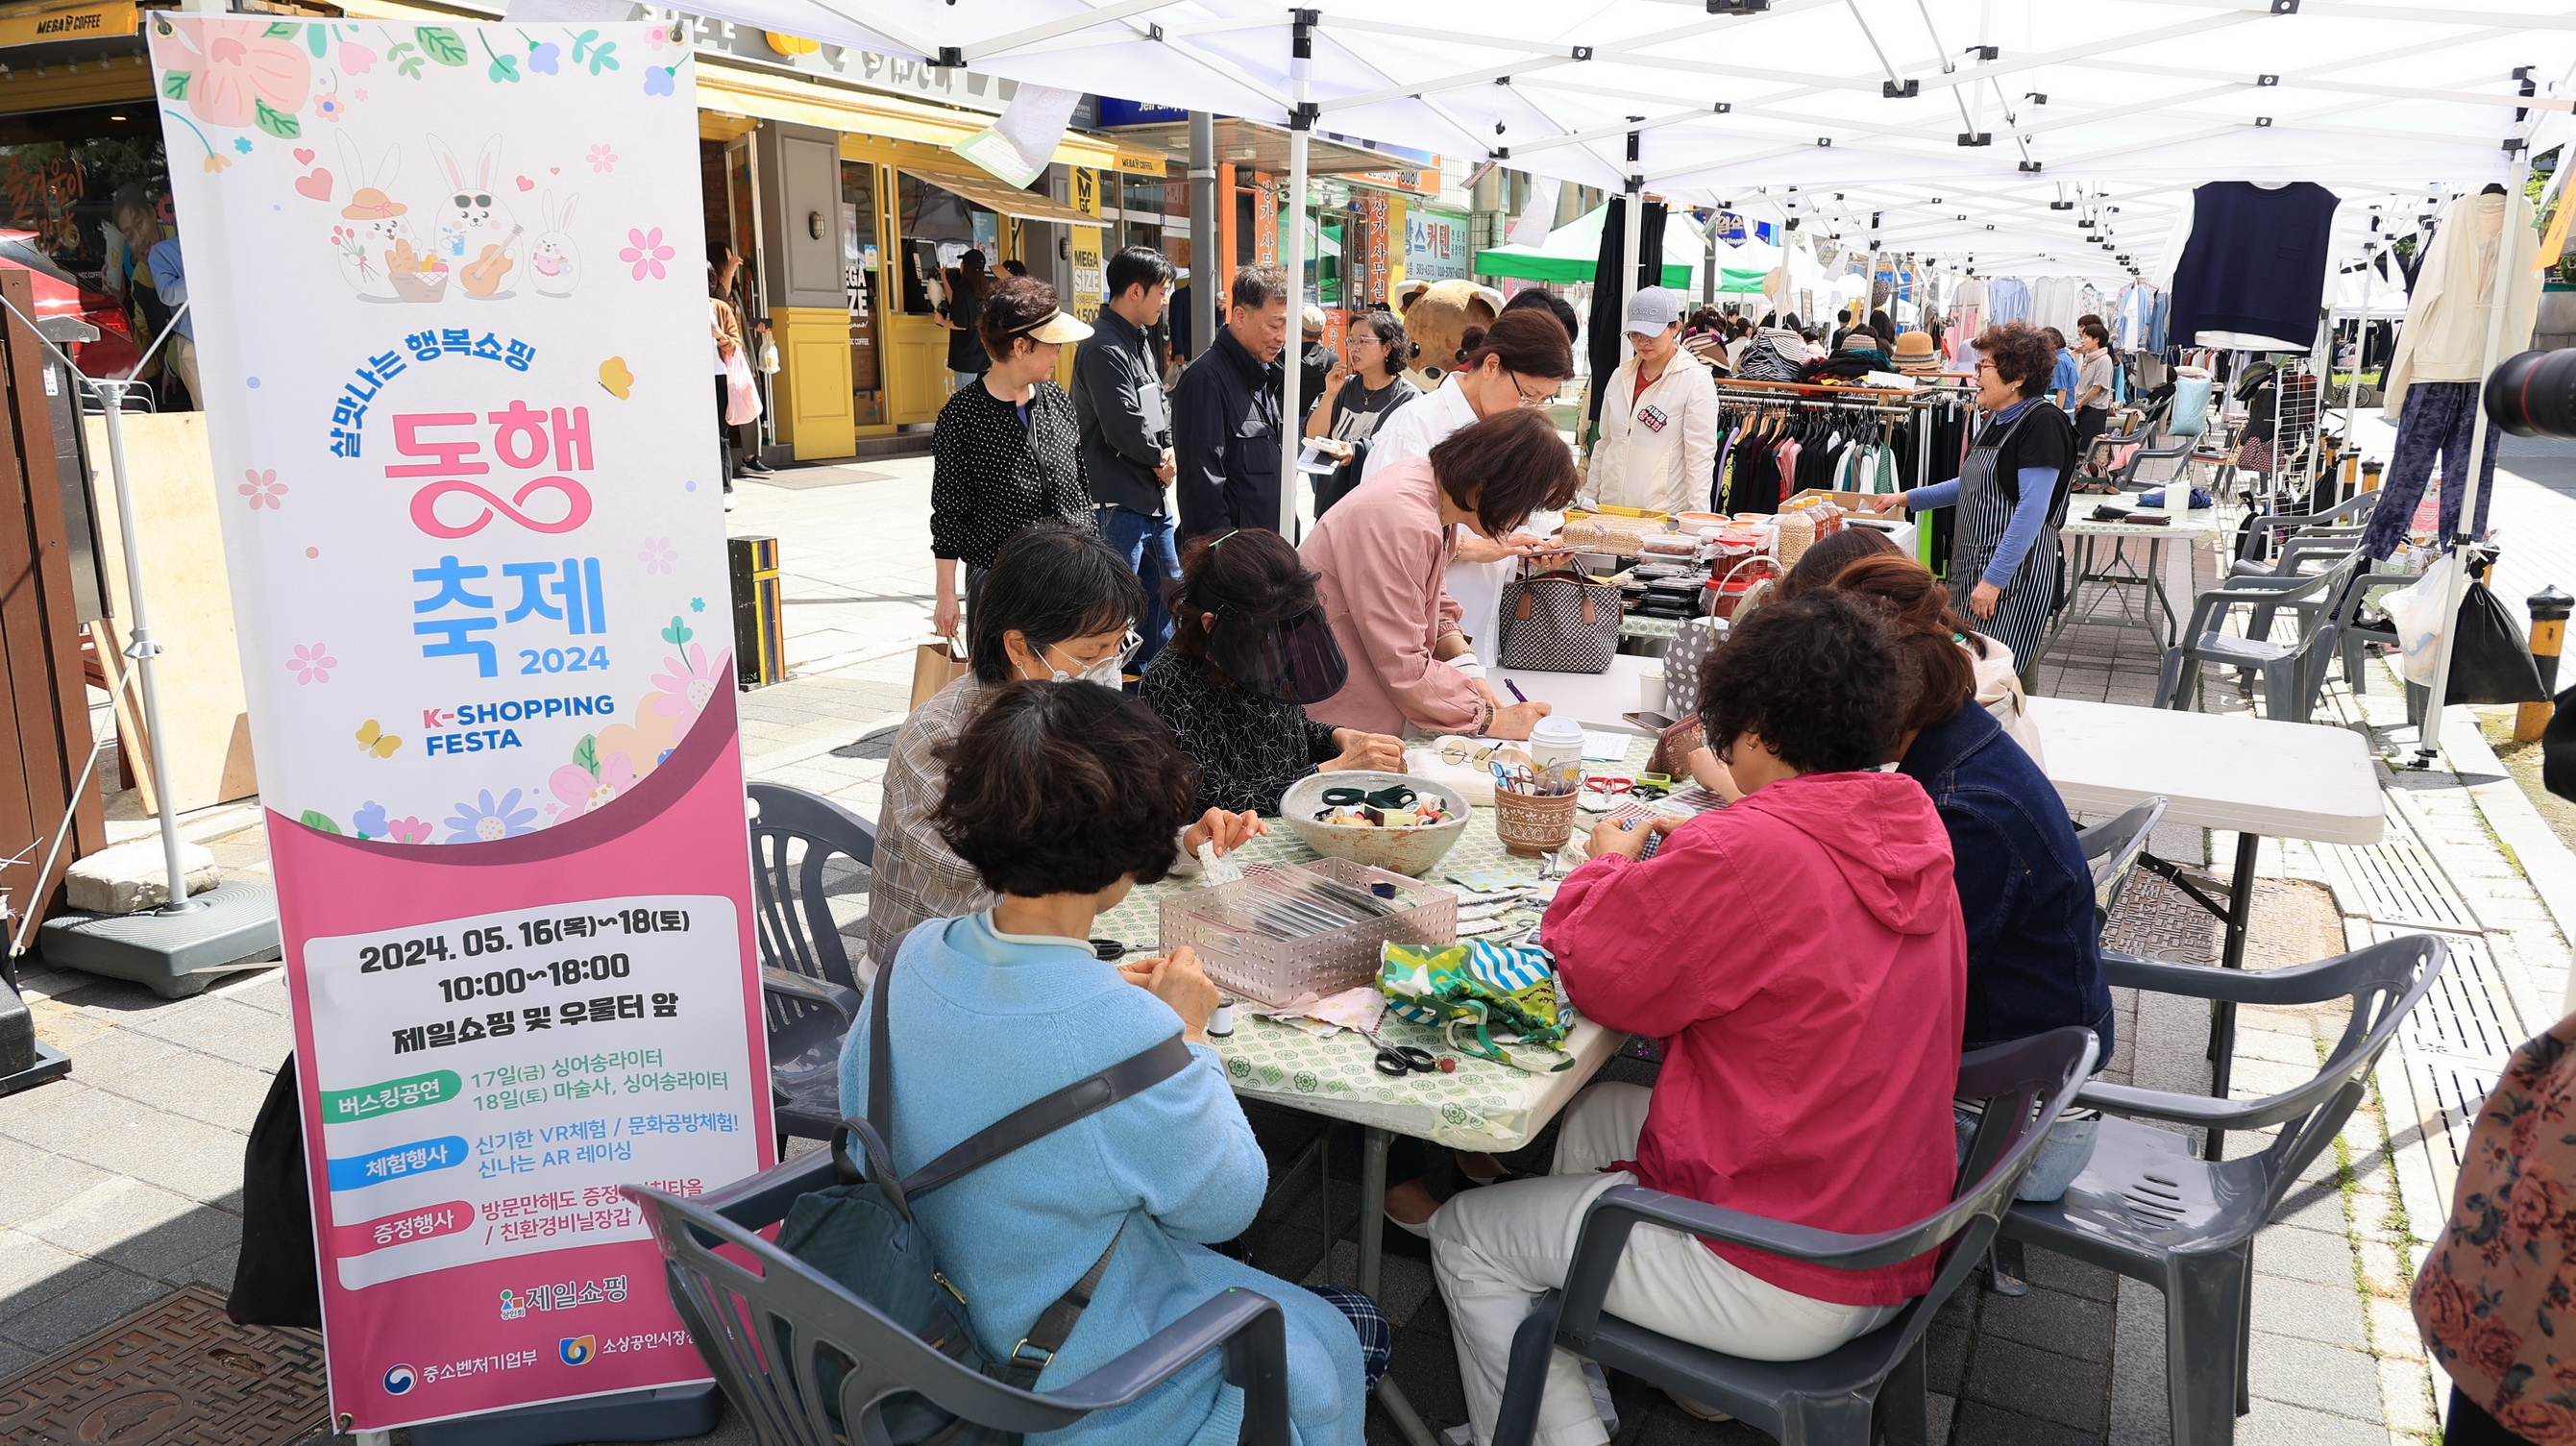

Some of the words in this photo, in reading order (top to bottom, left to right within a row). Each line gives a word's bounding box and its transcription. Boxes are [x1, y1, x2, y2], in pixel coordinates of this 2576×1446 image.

[37, 18, 64, 35] MEGA
[73, 13, 102, 31] COFFEE
[1074, 250, 1098, 268] MEGA
[1073, 268, 1100, 293] SIZE
[331, 349, 408, 458] 살맛나는
[404, 328, 537, 373] 행복쇼핑
[412, 554, 607, 678] 축제
[518, 645, 610, 675] 2024
[423, 694, 615, 729] K-SHOPPING
[426, 728, 523, 756] FESTA
[359, 936, 456, 974] 2024.
[462, 928, 513, 958] 05.
[519, 907, 690, 947] 16(목)~18(토)
[437, 952, 630, 1003] 10:00~18:00
[392, 1010, 515, 1054] 제일쇼핑
[526, 1005, 552, 1033] 및
[559, 994, 645, 1026] 우물터
[650, 993, 678, 1018] 앞
[470, 1064, 546, 1089] 17일(금)
[551, 1048, 664, 1078] 싱어송라이터
[338, 1078, 441, 1116] 버스킹공연
[472, 1087, 548, 1112] 18일(토)
[552, 1078, 617, 1101] 마술사,
[622, 1070, 728, 1095] 싱어송라이터
[475, 1130, 534, 1156] 신기한
[539, 1119, 607, 1143] VR체험
[613, 1117, 621, 1138] /
[626, 1112, 740, 1137] 문화공방체험!
[365, 1143, 448, 1178] 체험행사
[477, 1155, 536, 1180] 신나는
[541, 1148, 570, 1167] AR
[576, 1140, 631, 1164] 레이싱
[480, 1192, 577, 1221] 방문만해도
[372, 1209, 454, 1245] 증정행사
[483, 1226, 494, 1246] /
[500, 1206, 631, 1243] 친환경비닐장갑
[526, 1274, 628, 1311] 제일쇼핑
[503, 1308, 526, 1319] 상인회
[423, 1348, 538, 1384] 중소벤처기업부
